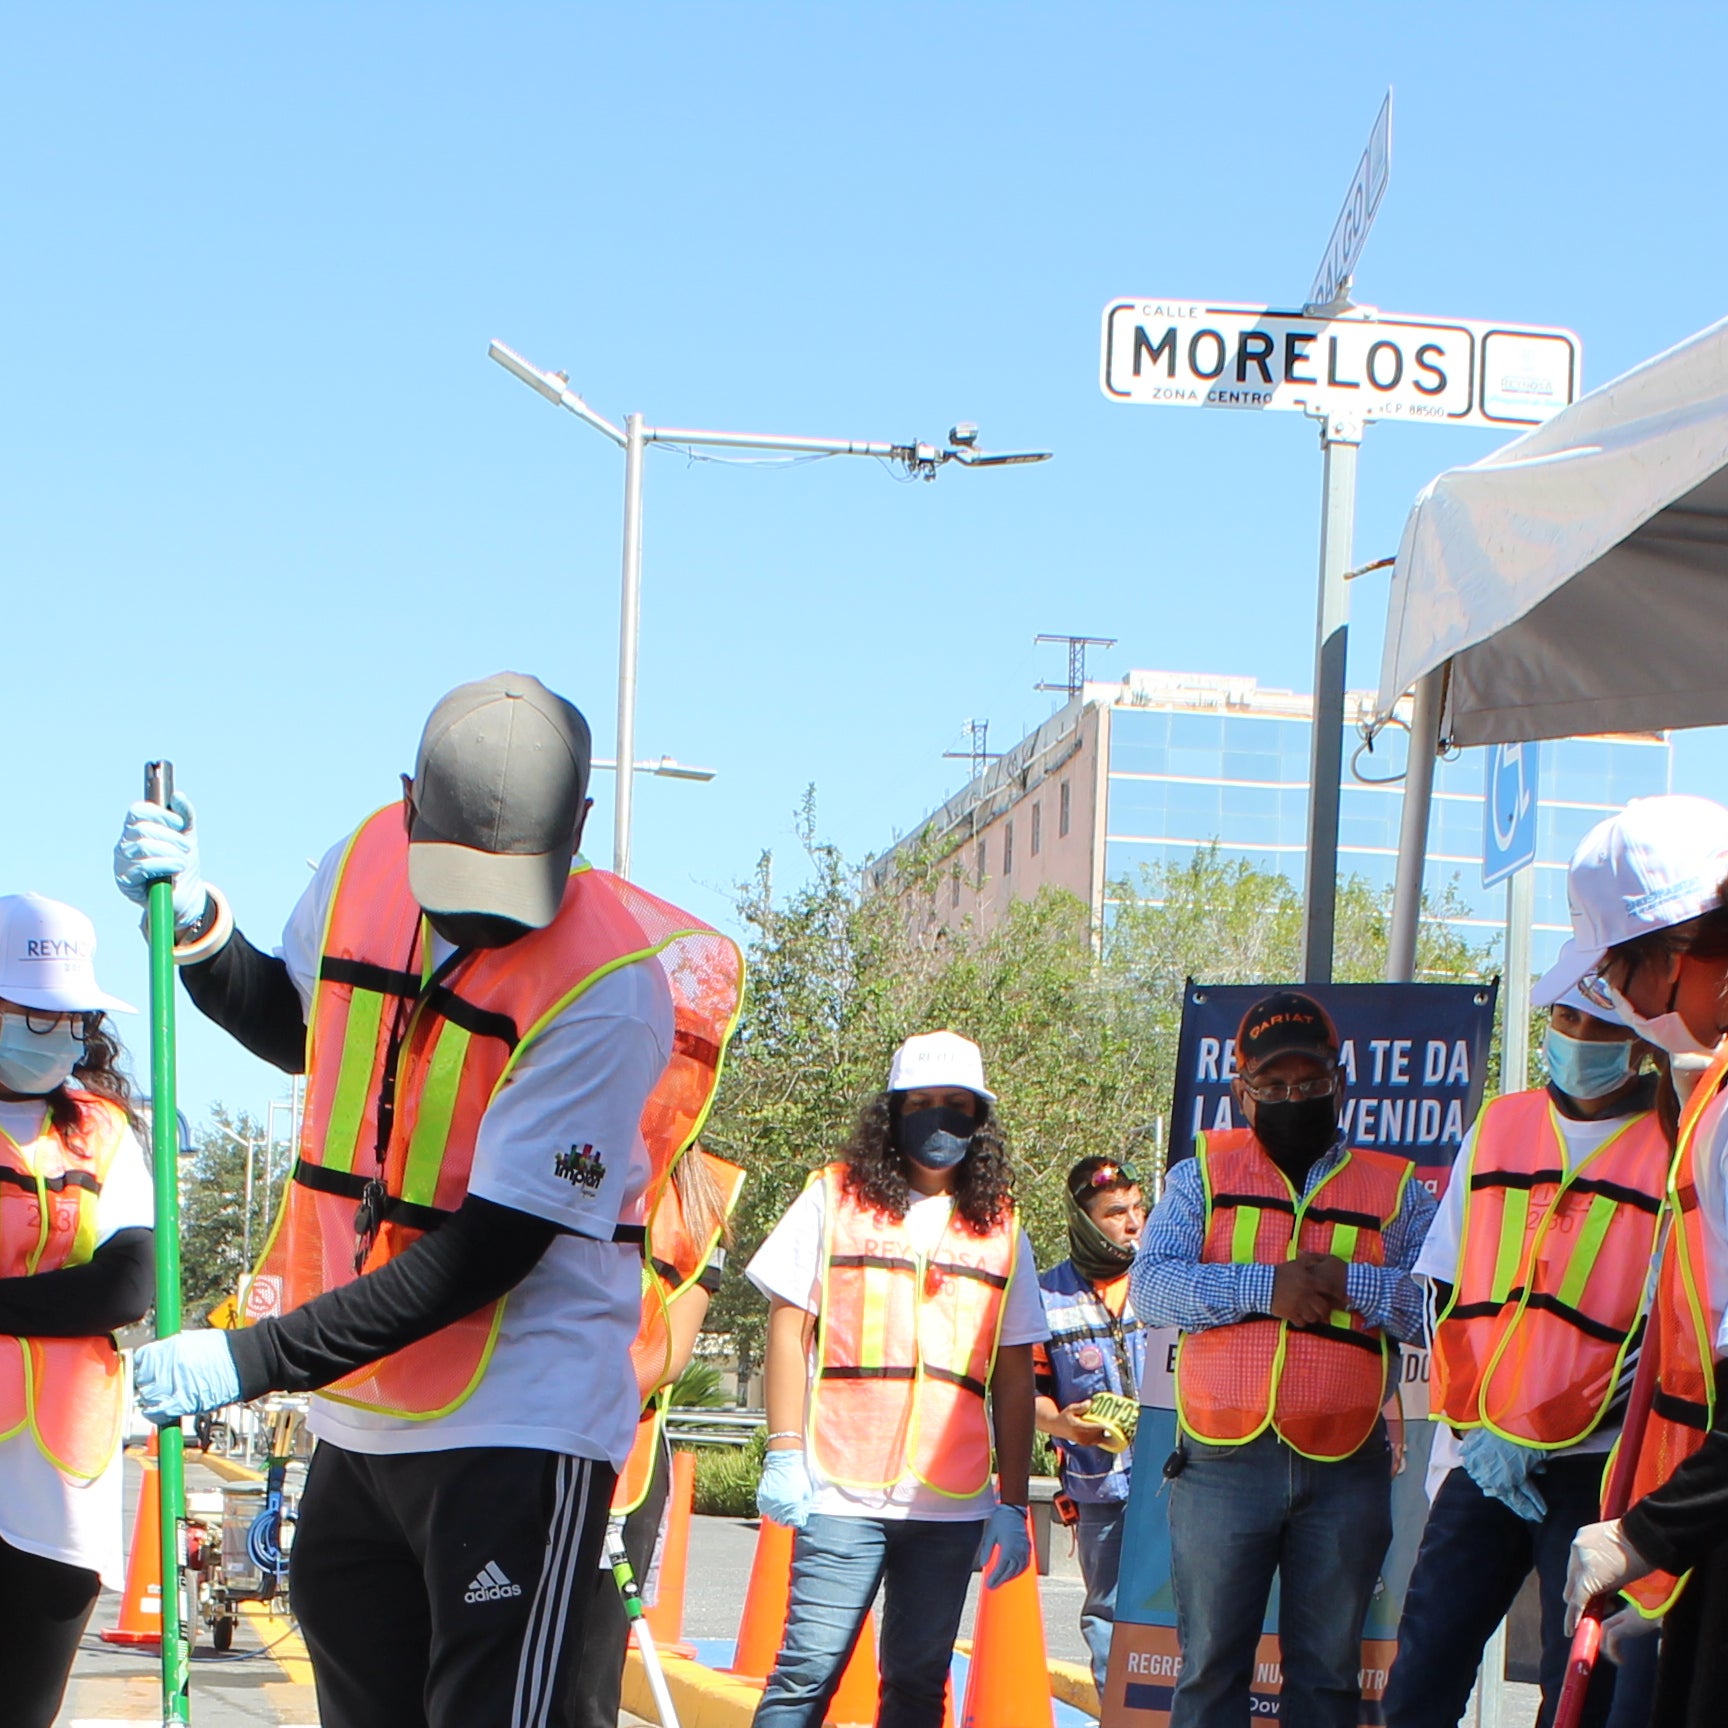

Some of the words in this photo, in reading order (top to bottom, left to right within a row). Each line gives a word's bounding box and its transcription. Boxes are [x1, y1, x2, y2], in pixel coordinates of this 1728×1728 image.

[1314, 182, 1364, 305] DALGO
[1142, 305, 1199, 319] CALLE
[1132, 325, 1449, 396] MORELOS
[1152, 387, 1198, 401] ZONA
[1207, 391, 1273, 405] CENTRO
[27, 938, 80, 958] REYN
[1367, 1039, 1413, 1087] TE
[1422, 1039, 1471, 1087] DA
[1336, 1098, 1464, 1146] VENIDA
[464, 1583, 522, 1604] adidas
[1128, 1652, 1183, 1677] REGRE
